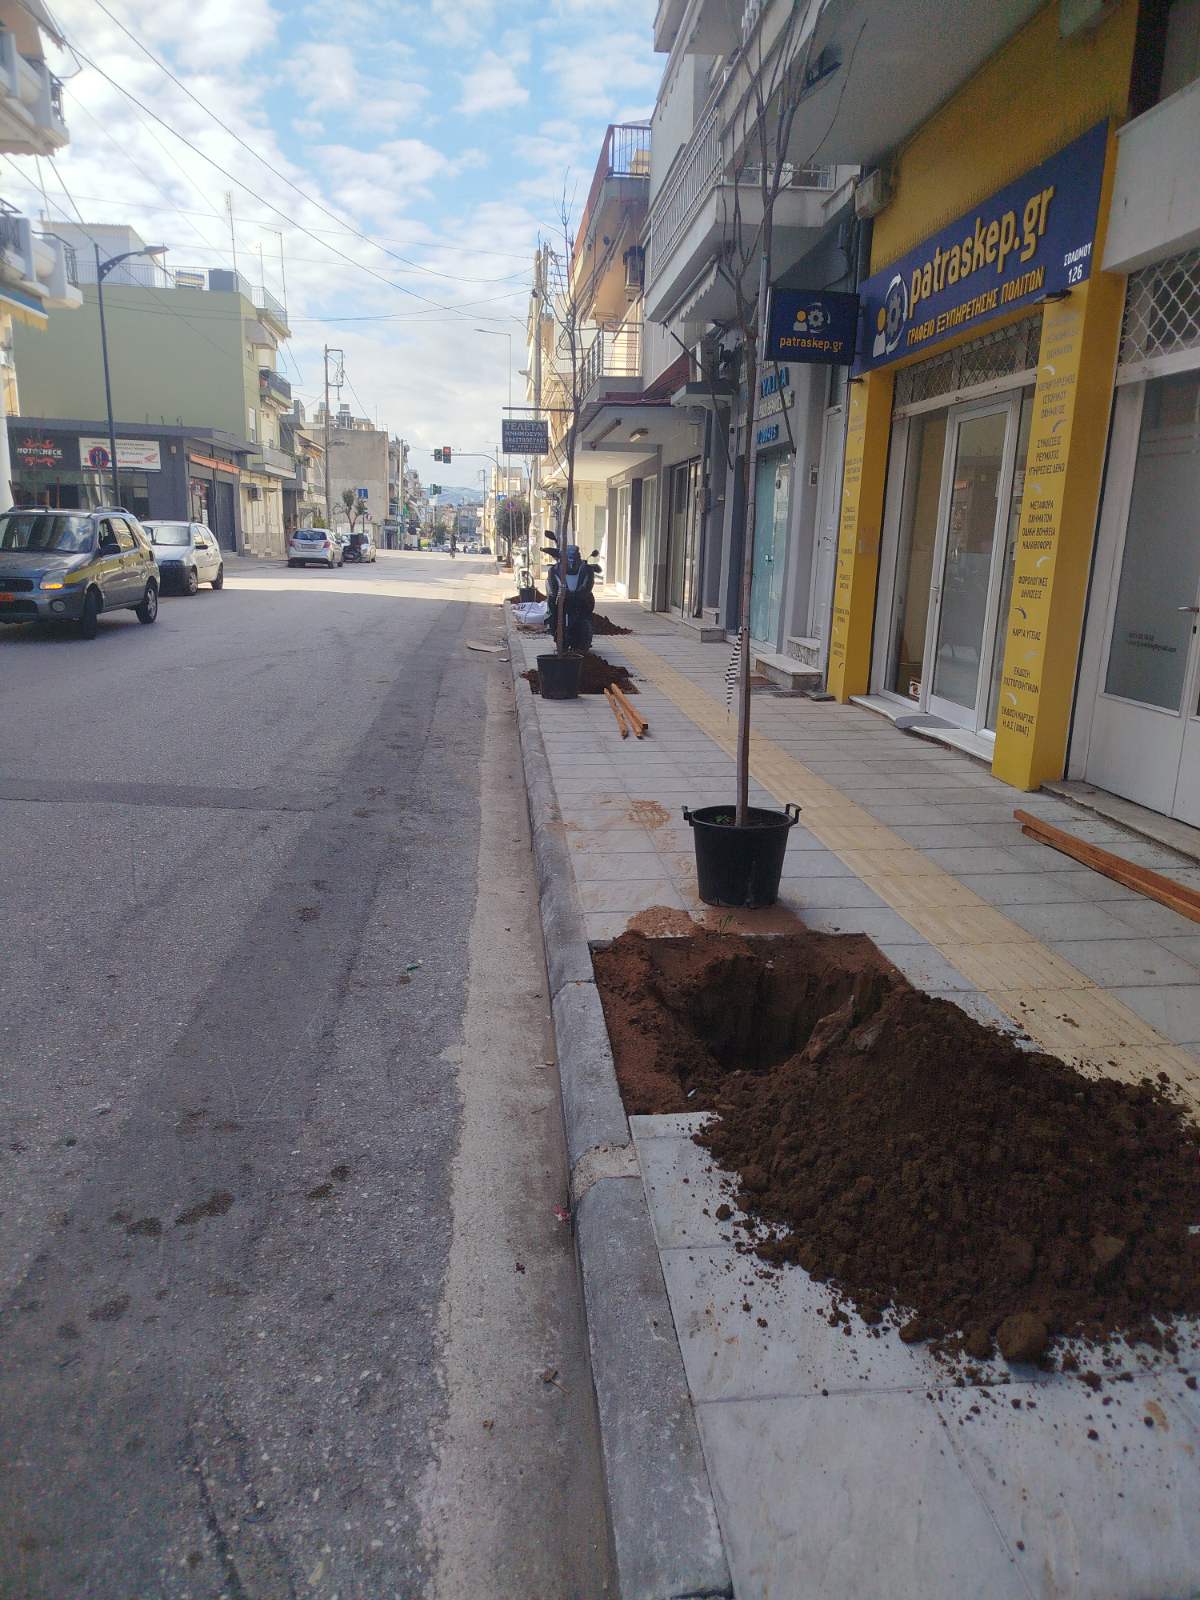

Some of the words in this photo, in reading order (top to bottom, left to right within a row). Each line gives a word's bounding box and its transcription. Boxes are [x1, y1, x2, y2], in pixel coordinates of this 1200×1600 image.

[909, 186, 1055, 320] patraskep.gr
[1069, 264, 1083, 284] 126
[907, 319, 935, 346] ΓΡΑΦΕΙΟ
[937, 288, 999, 335] ΕΞΥΠΗΡΕΤΗΣΗΣ
[1001, 266, 1045, 305] ΠΟΛΙΤΩΝ
[779, 335, 844, 352] patraskep.gr
